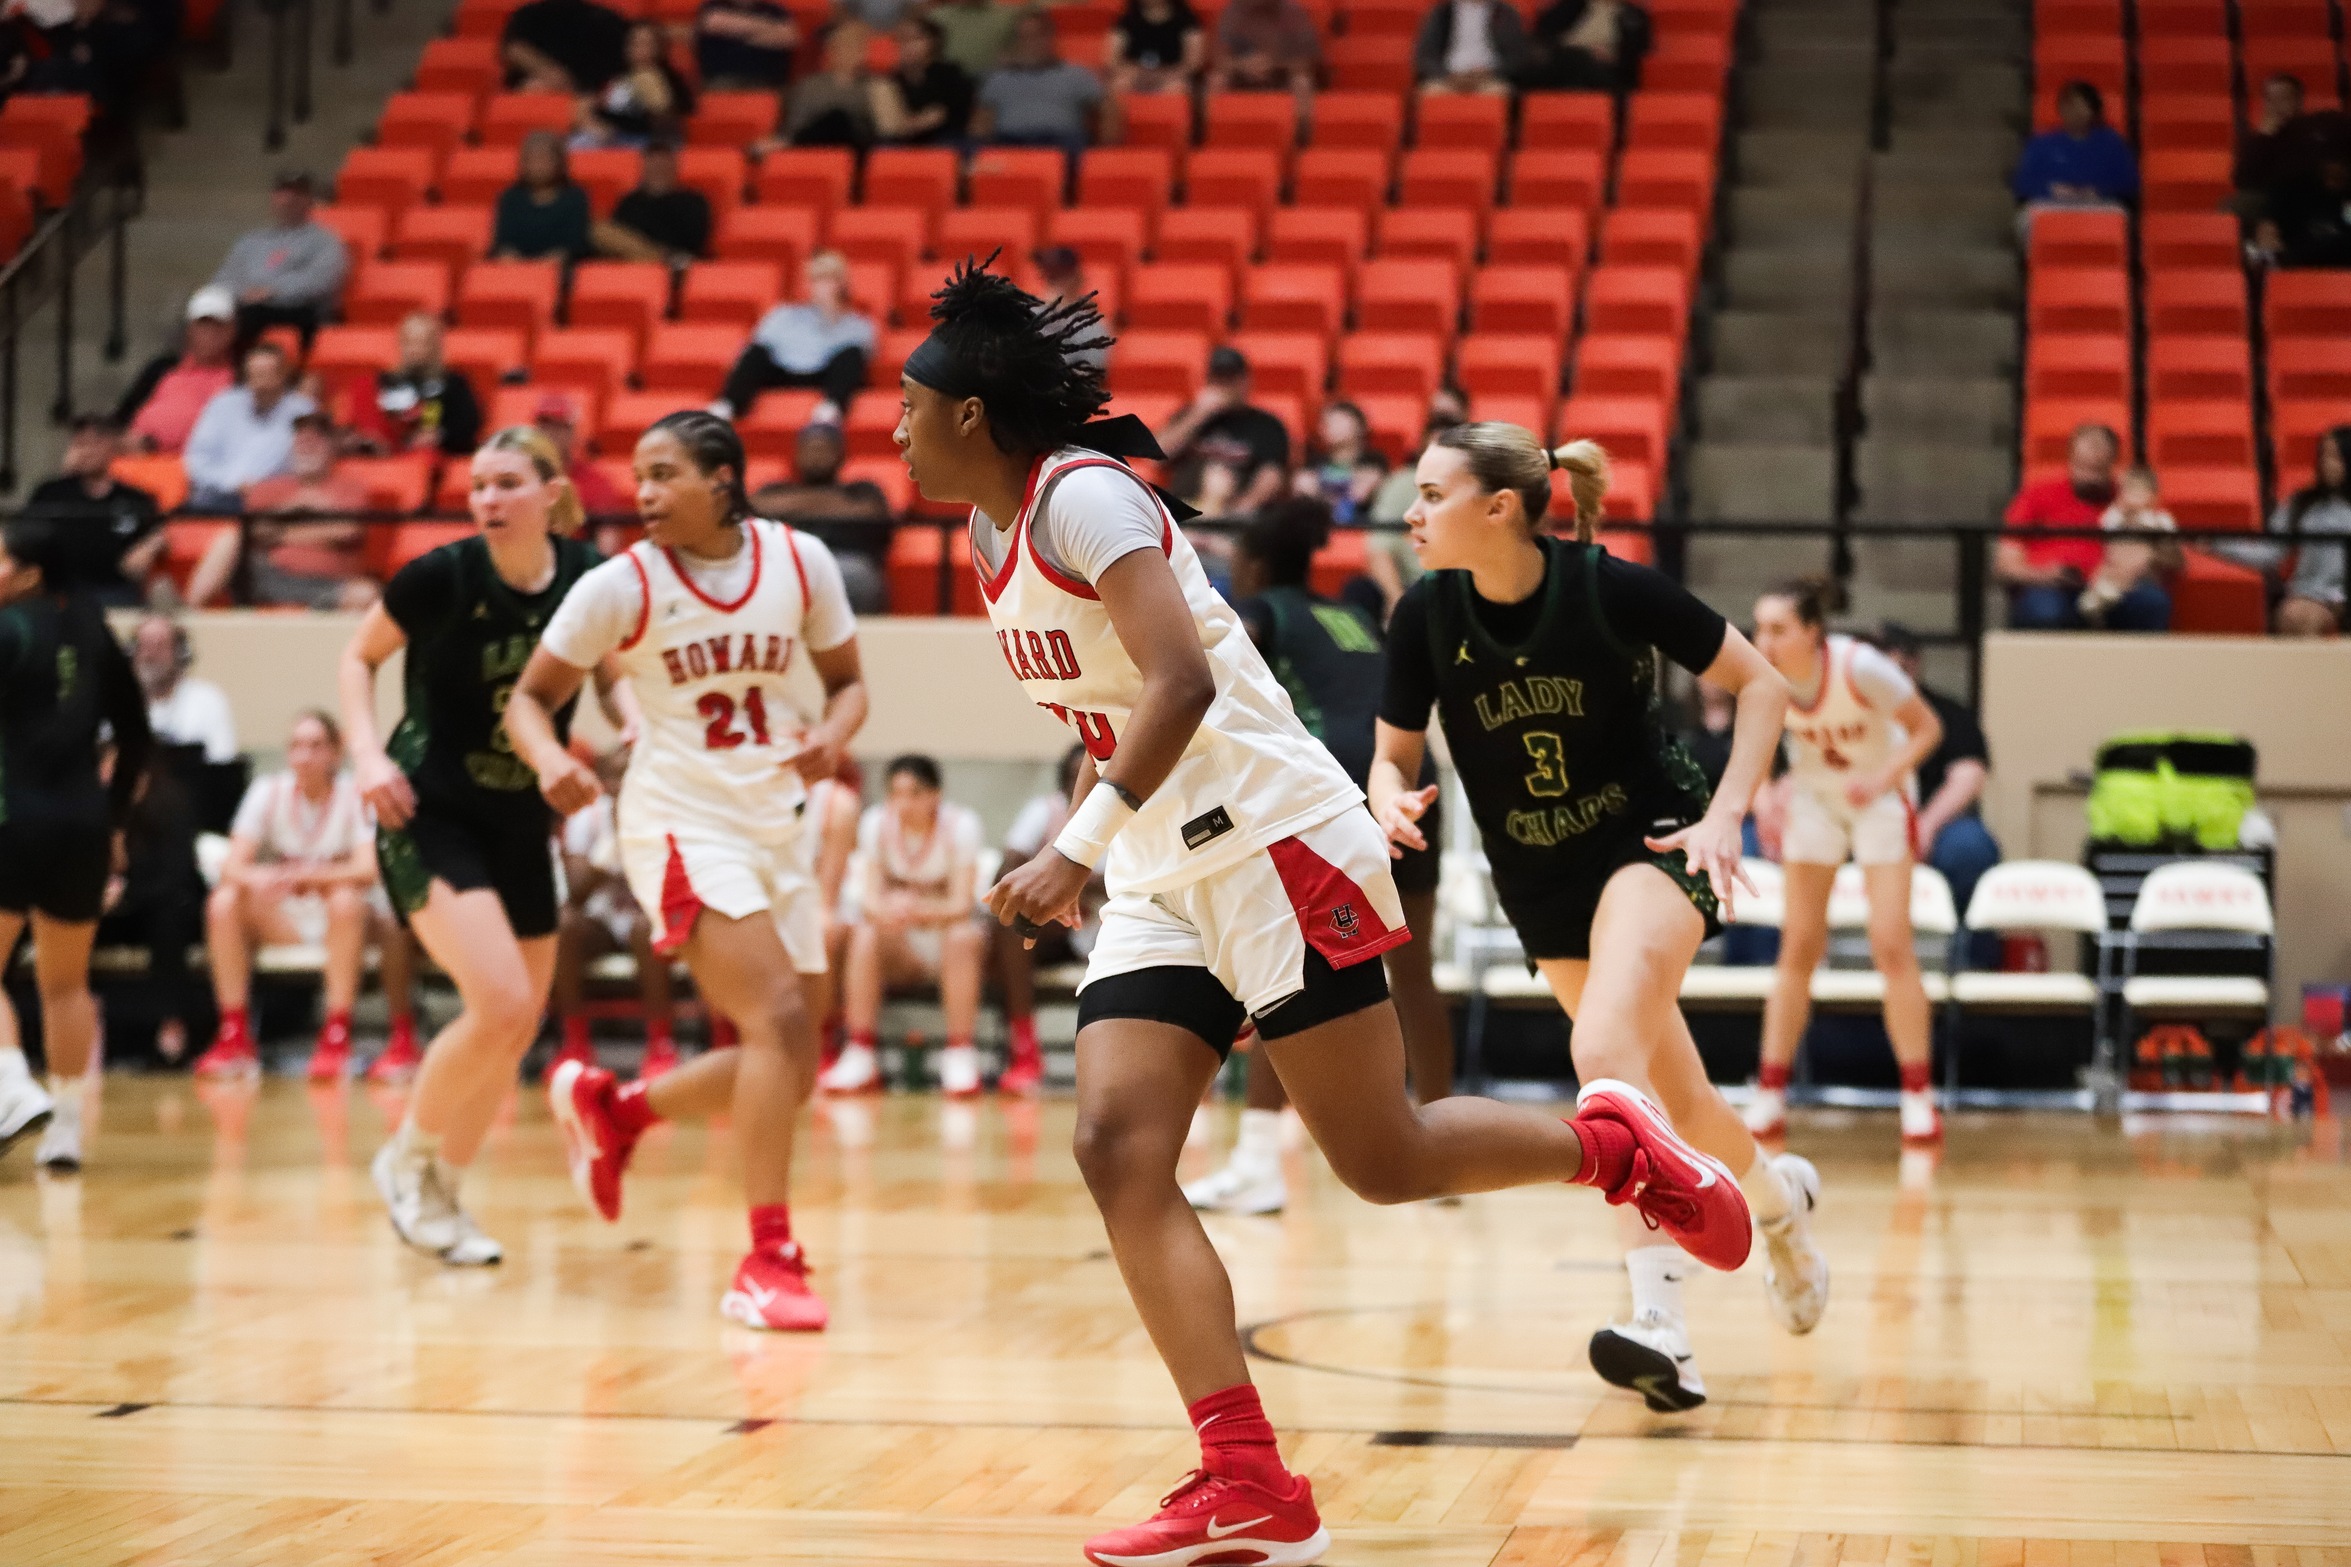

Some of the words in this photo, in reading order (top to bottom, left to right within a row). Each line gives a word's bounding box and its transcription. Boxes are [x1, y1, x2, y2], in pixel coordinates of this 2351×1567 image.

[662, 633, 794, 685] HOWARD
[696, 685, 772, 749] 21
[1474, 676, 1584, 731] LADY
[1522, 731, 1569, 797] 3
[1212, 815, 1224, 827] M
[1506, 783, 1628, 846] CHAPS
